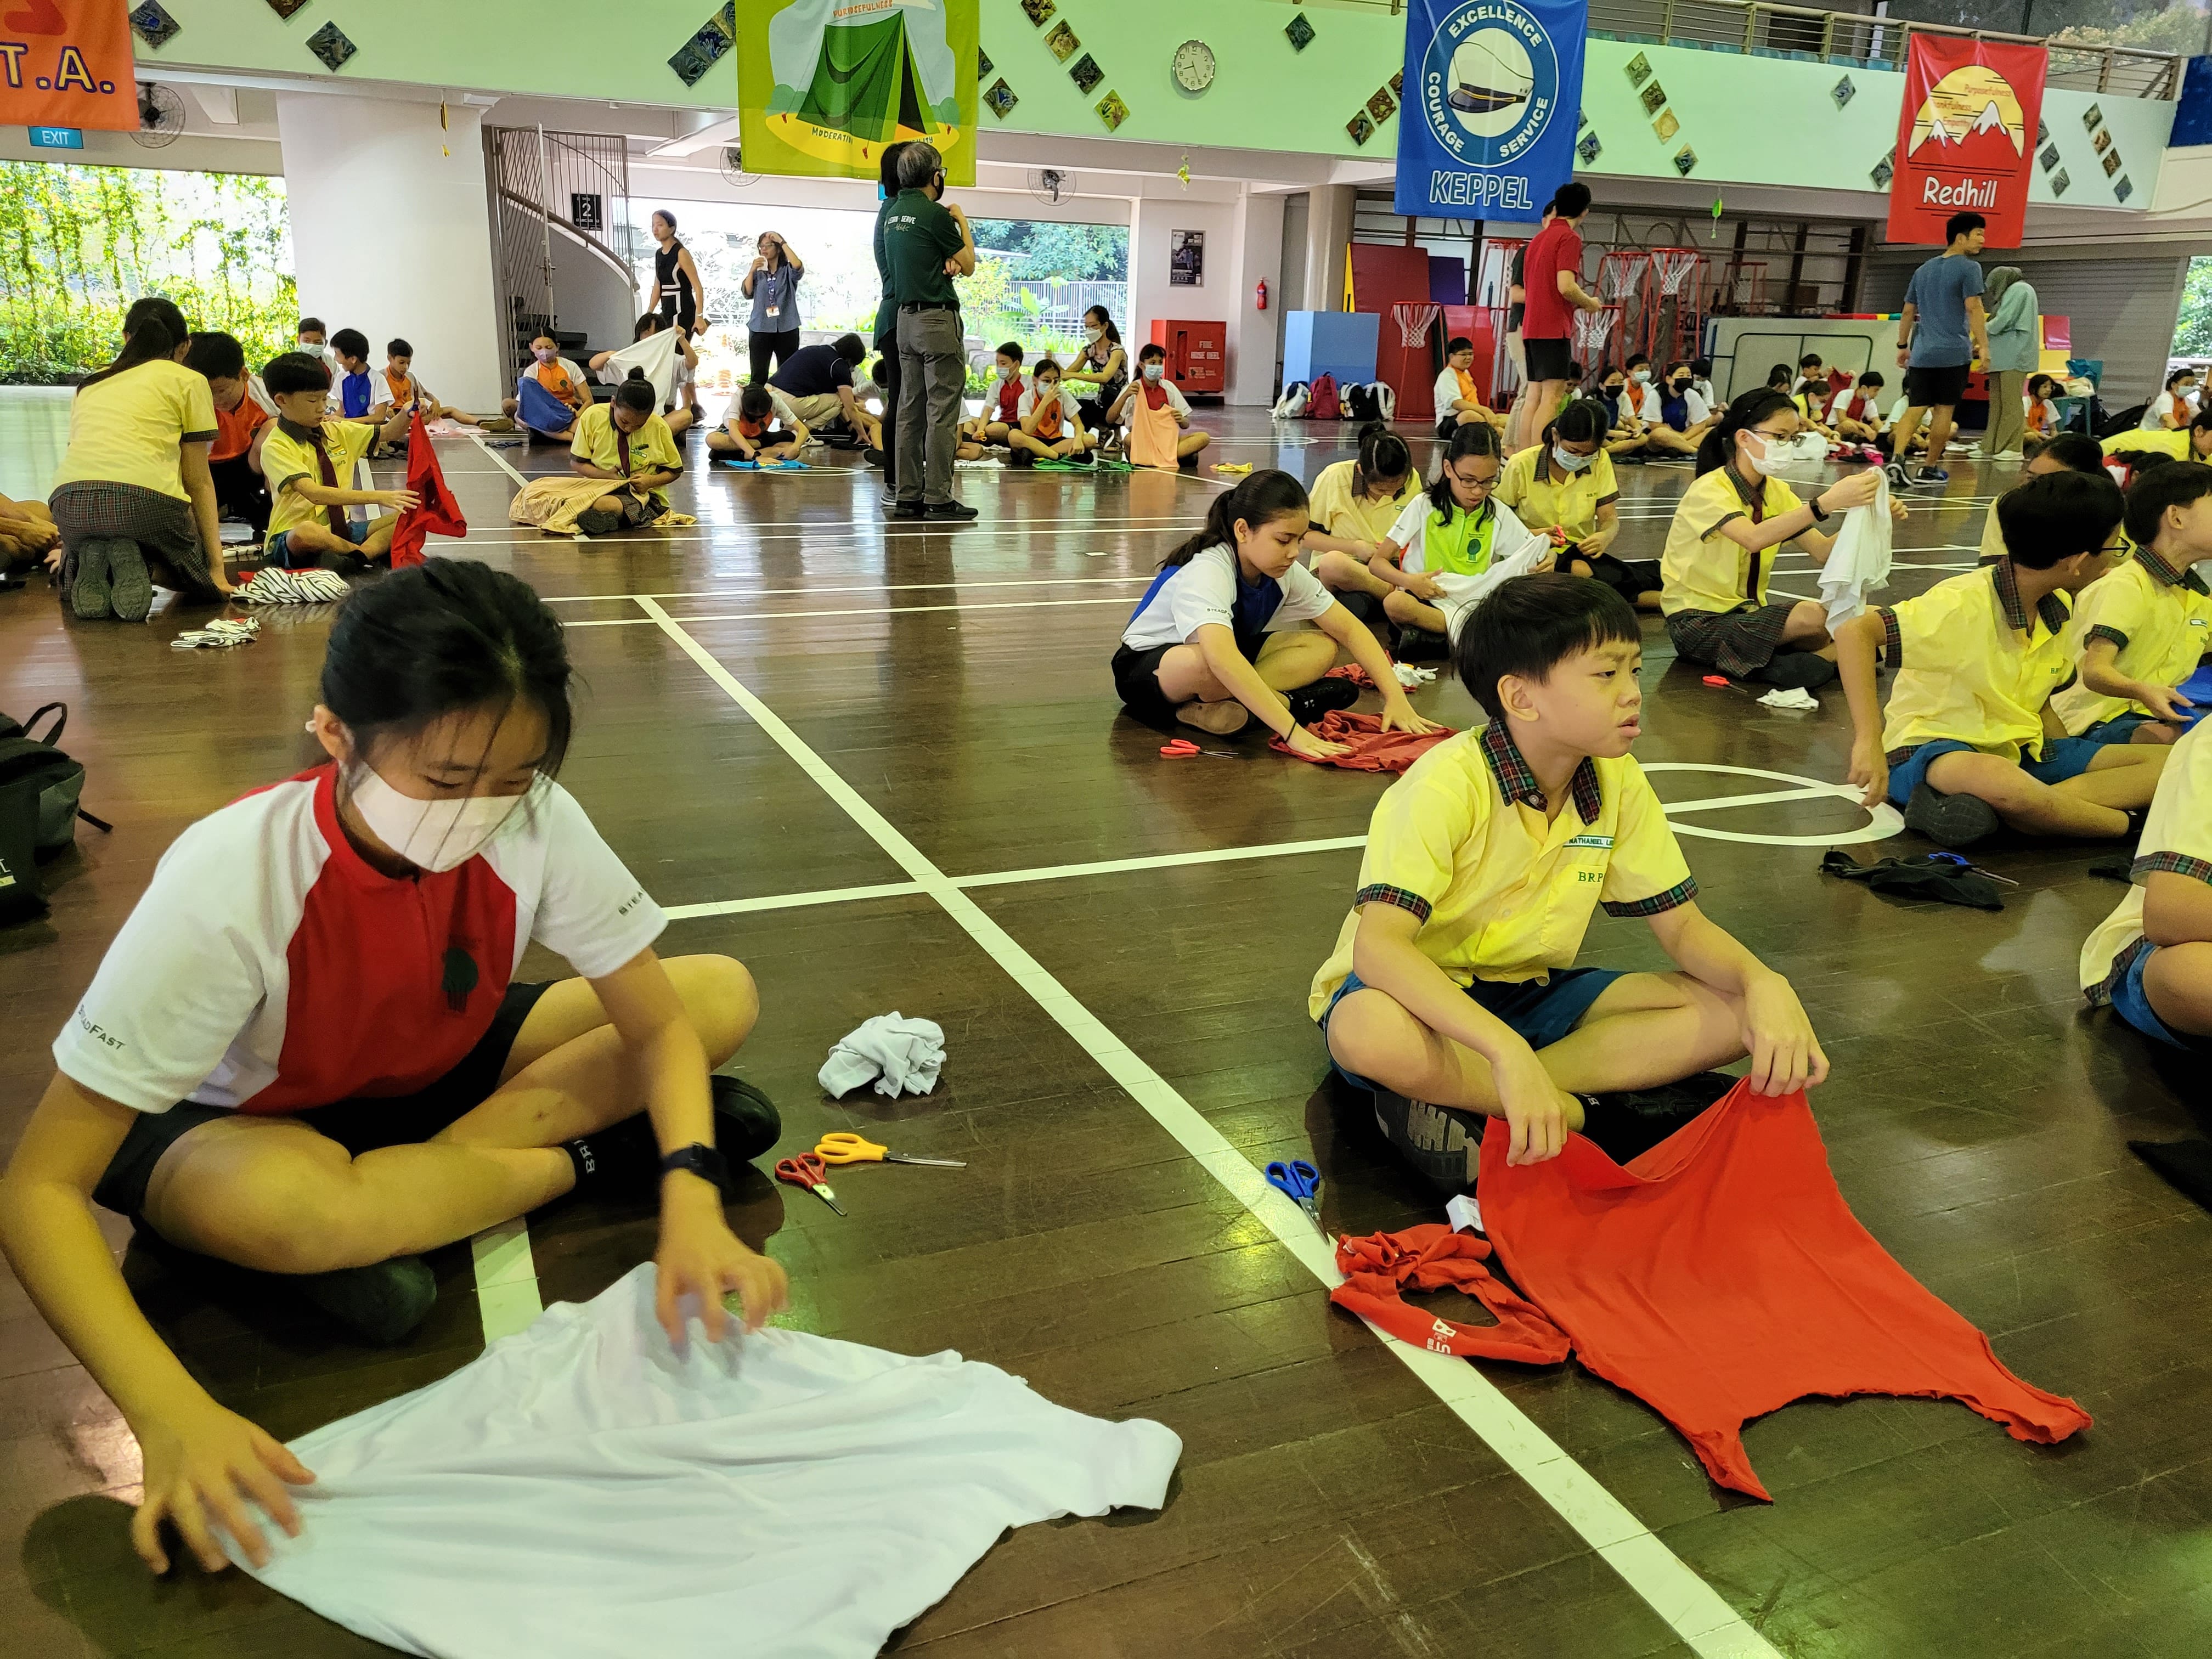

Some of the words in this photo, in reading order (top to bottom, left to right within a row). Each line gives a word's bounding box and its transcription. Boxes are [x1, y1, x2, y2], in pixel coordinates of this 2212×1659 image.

[1448, 5, 1543, 47] EXCELLENCE
[1427, 72, 1465, 153] COURAGE
[1499, 97, 1549, 157] SERVICE
[41, 130, 69, 145] EXIT
[1429, 170, 1533, 210] KEPPEL
[1923, 176, 1997, 208] Redhill
[582, 202, 591, 217] 2
[901, 215, 916, 224] SERVE
